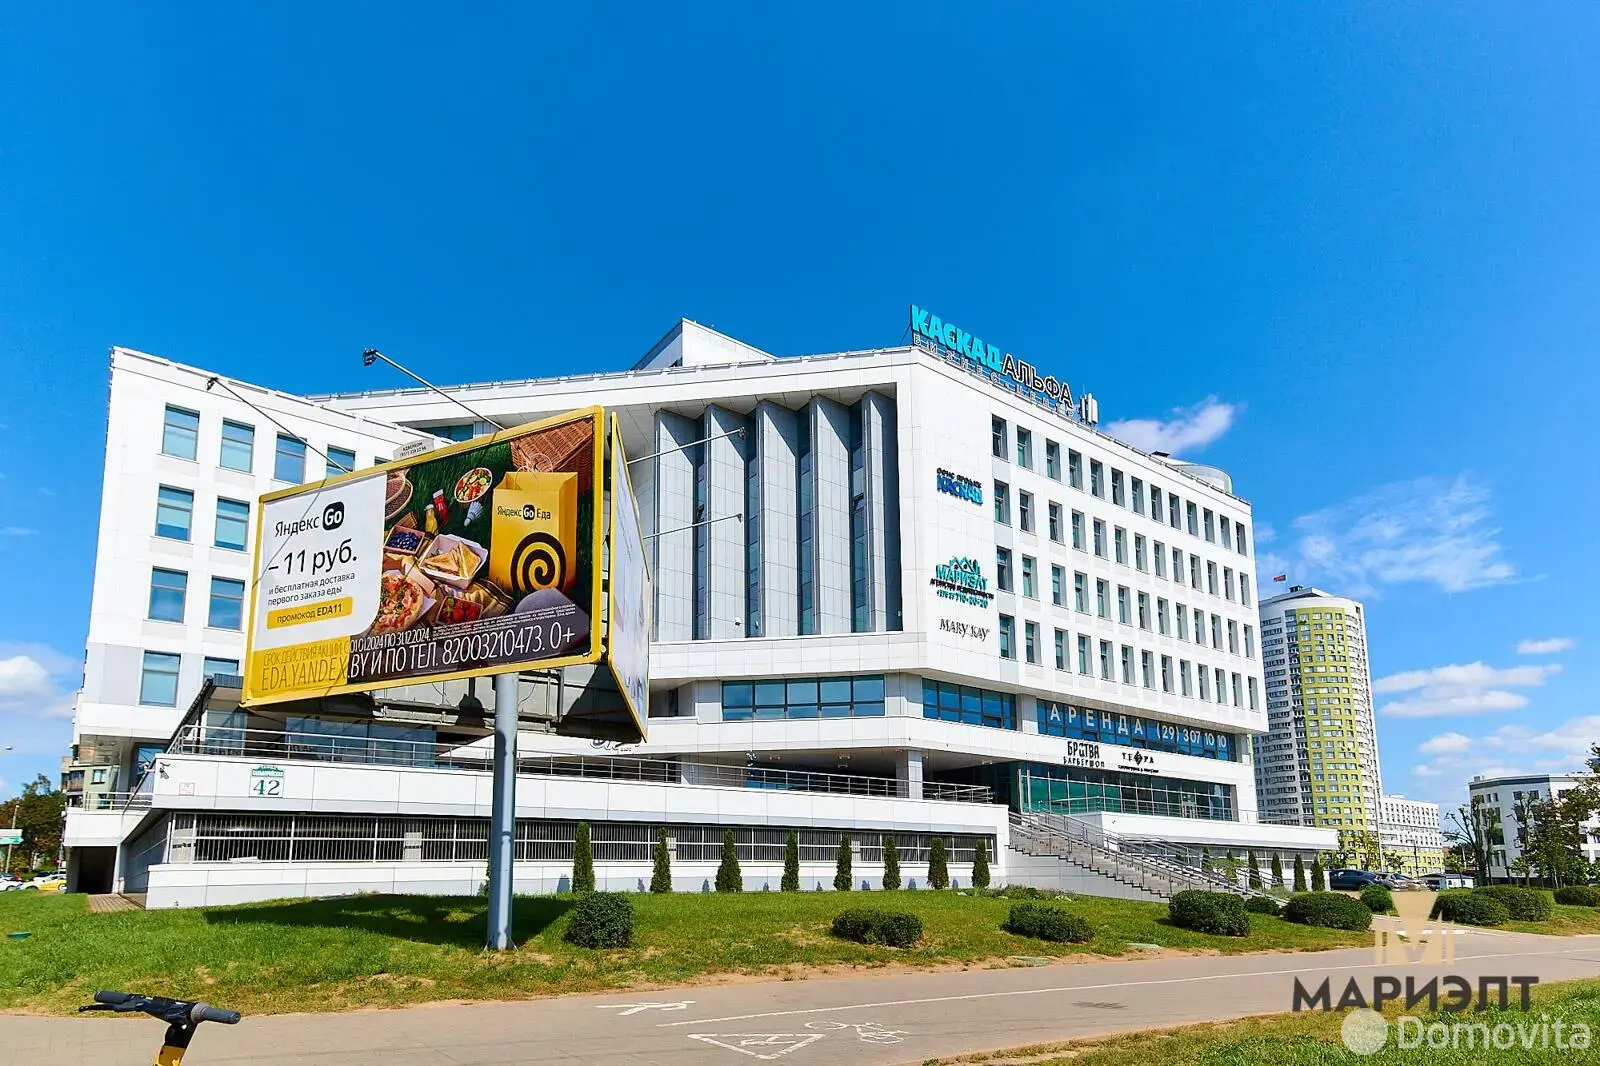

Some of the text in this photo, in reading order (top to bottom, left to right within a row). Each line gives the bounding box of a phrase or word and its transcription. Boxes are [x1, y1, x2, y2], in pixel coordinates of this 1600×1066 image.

[910, 304, 1074, 408] КАСКАД АЛЬФА
[497, 505, 522, 517] Яндекс
[536, 508, 551, 520] Еда
[275, 516, 320, 537] Яндекс
[311, 538, 357, 576] руб.
[274, 579, 318, 595] бесплатная
[319, 572, 356, 586] доставка
[267, 585, 342, 607] первого заказа еды
[276, 603, 342, 624] промокод EDA11
[940, 618, 989, 641] MARY KAY
[370, 650, 382, 676] И
[385, 647, 407, 674] ПО
[409, 642, 438, 670] ТЕЛ.
[442, 624, 545, 665] 82003210473.
[550, 621, 575, 649] 0+
[1050, 703, 1227, 748] АРЕНДА (29) 307 10 10
[253, 779, 280, 796] 42
